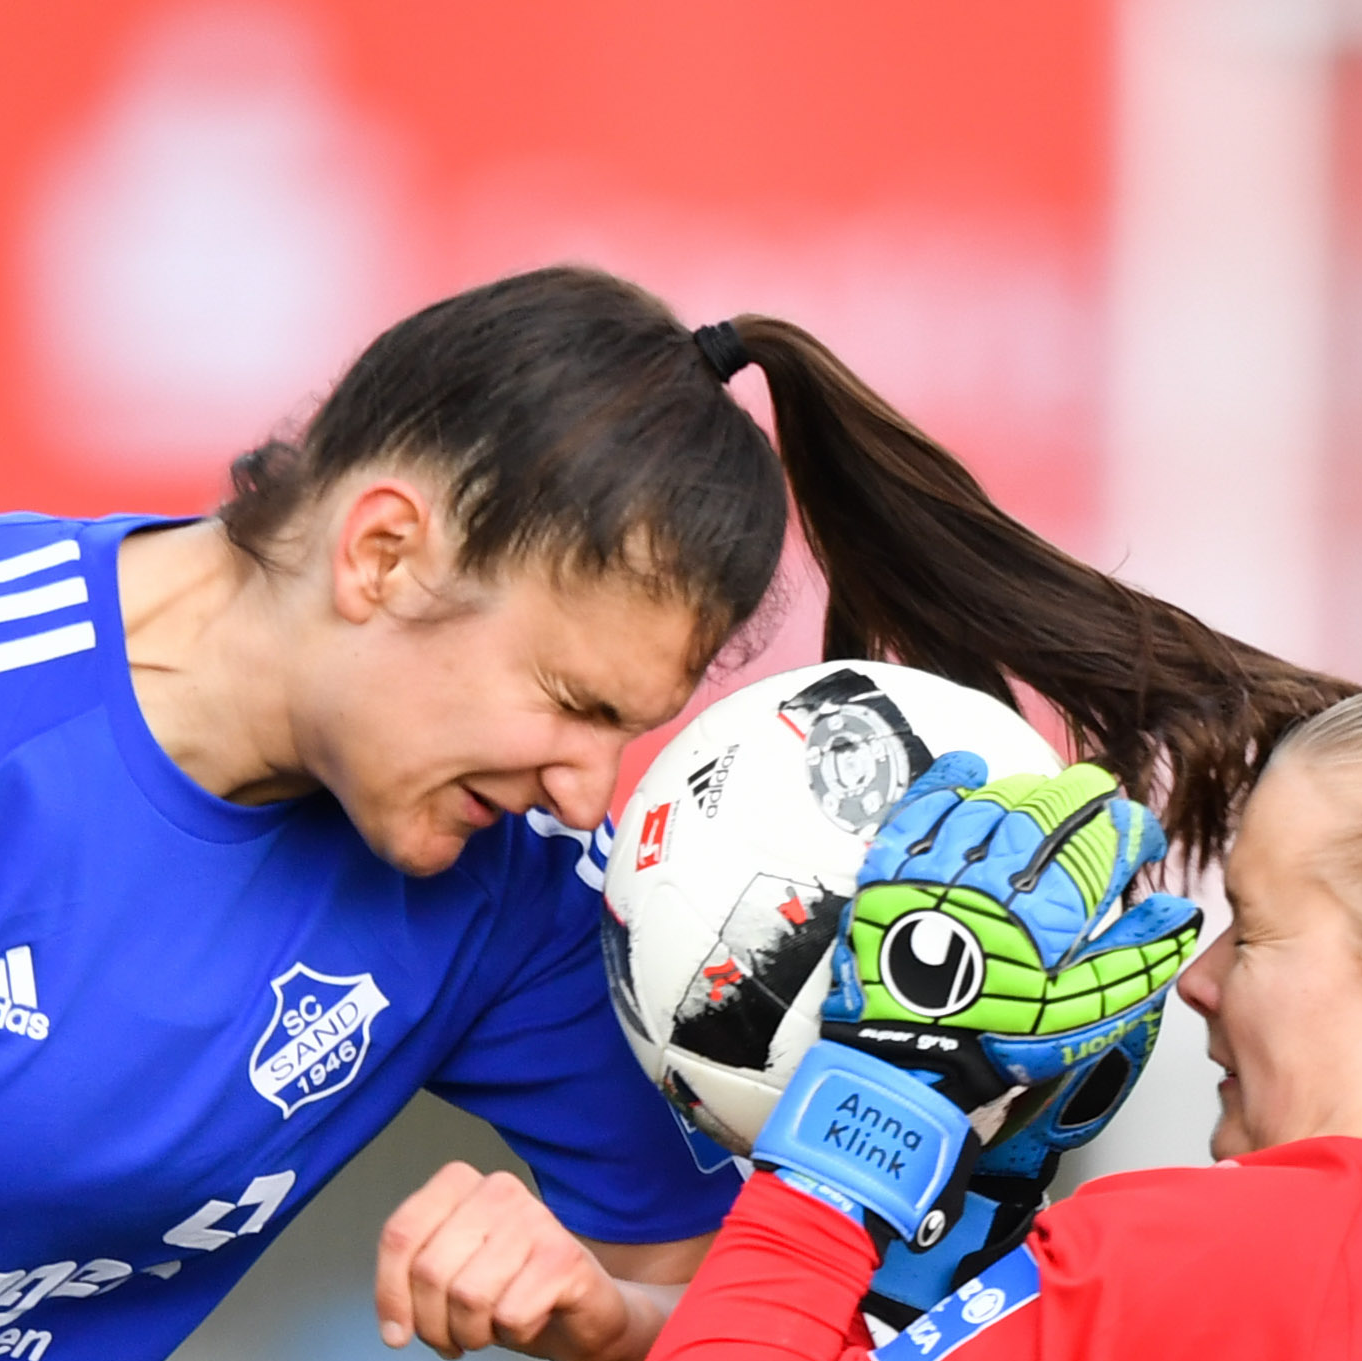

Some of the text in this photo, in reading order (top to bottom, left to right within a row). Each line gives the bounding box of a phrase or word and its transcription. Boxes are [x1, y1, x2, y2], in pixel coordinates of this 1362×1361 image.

[270, 1001, 358, 1081] SAND
[282, 995, 322, 1036] SC
[297, 1039, 357, 1094] 1946
[823, 1119, 906, 1180] Klink
[836, 1093, 923, 1152] Anna
